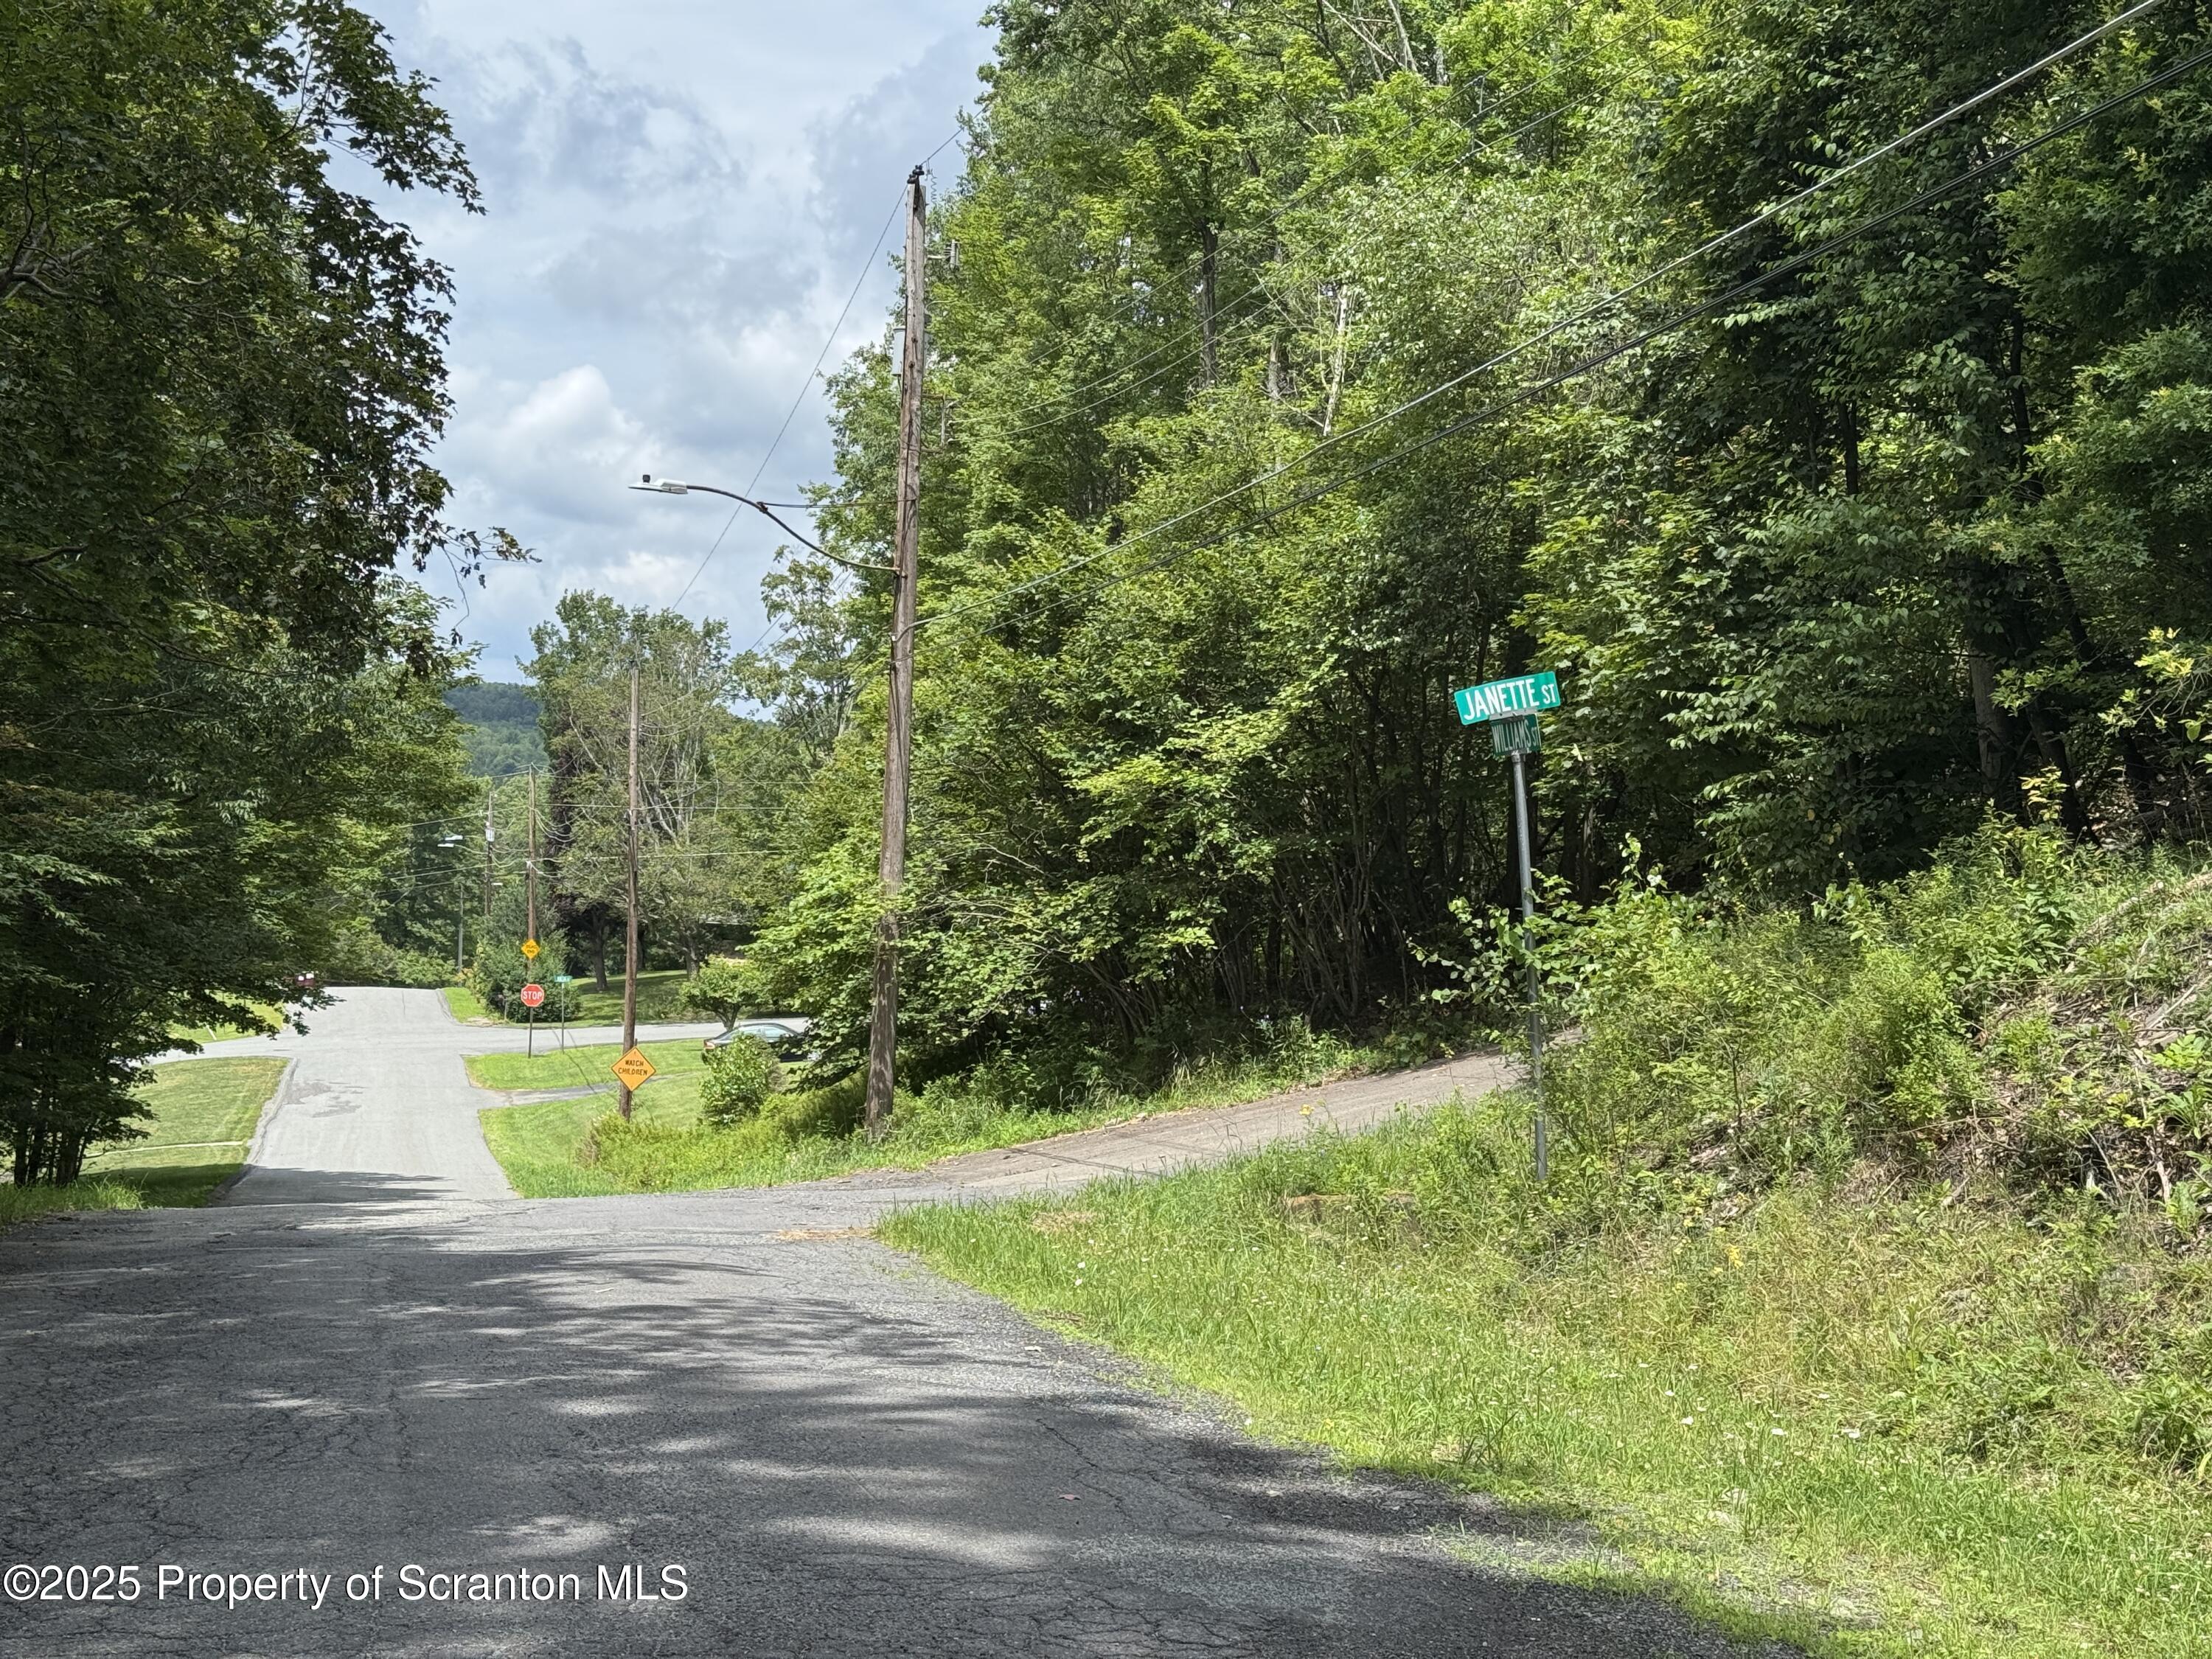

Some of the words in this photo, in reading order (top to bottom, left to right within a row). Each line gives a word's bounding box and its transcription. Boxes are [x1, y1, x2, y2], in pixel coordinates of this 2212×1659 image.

[1464, 678, 1540, 720] JANETTE
[1541, 684, 1557, 705] ST
[1492, 720, 1531, 753] WILLIAMS
[523, 991, 543, 1001] STOP
[618, 1067, 648, 1076] CHILDREN
